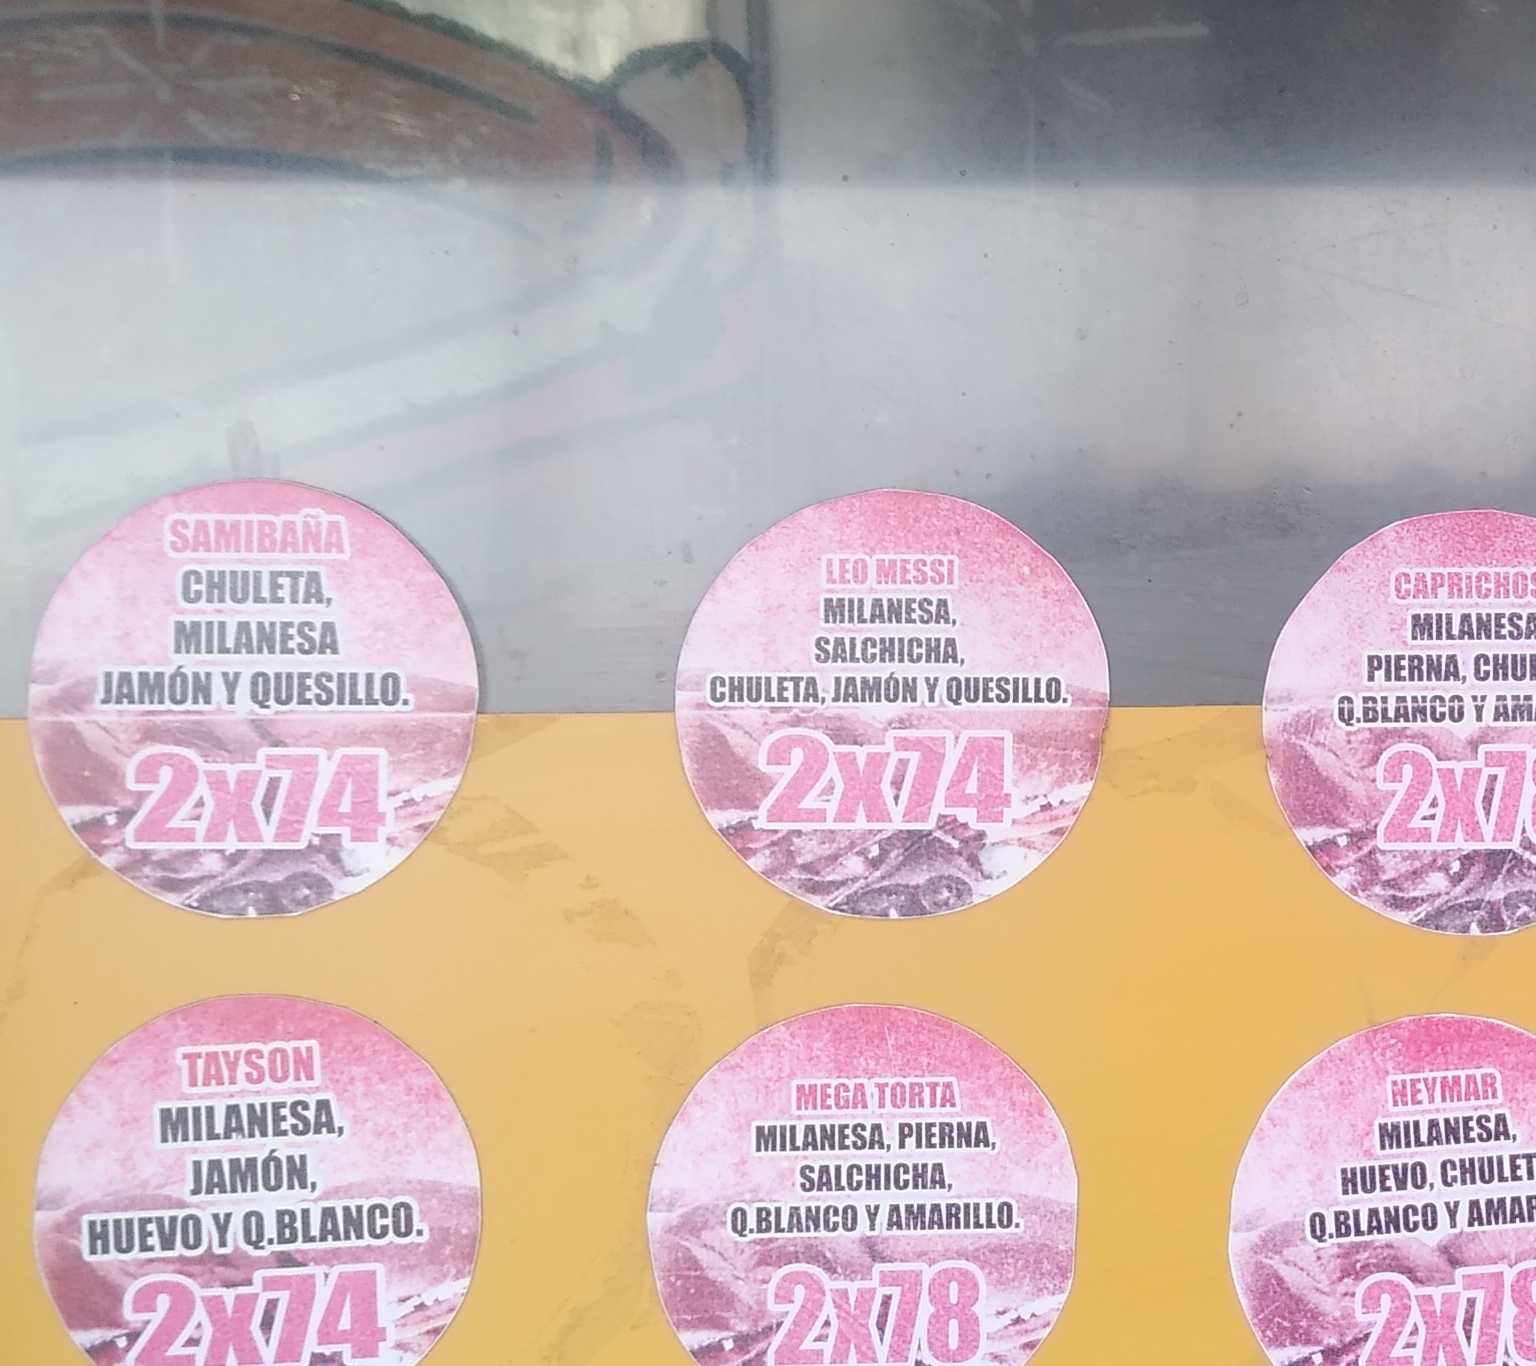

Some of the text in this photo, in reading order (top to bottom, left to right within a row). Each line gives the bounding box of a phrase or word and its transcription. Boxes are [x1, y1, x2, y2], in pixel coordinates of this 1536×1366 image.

[168, 513, 346, 555] SAMIBAÑA
[180, 569, 334, 608] CHULETA,
[824, 557, 956, 586] LEO MESSI
[822, 596, 959, 628] MILANESA,
[172, 619, 340, 656] MILANESA
[813, 635, 966, 667] SALCHICHA,
[1365, 652, 1468, 685] PIERNA,
[99, 665, 411, 710] JAMÓN Y QUESILLO.
[708, 671, 1070, 708] CHULETA, JAMÓN Y QUESILLO.
[1471, 694, 1489, 723] Y
[181, 1045, 316, 1089] TAYSON
[794, 1080, 957, 1111] MEGA TORTA
[1390, 1072, 1500, 1108] NEYMAR
[157, 1098, 345, 1144] MILANESA,
[753, 1120, 998, 1154] MILANESA, PIERNA,
[1376, 1112, 1518, 1151] MILANESA,
[188, 1147, 318, 1197] JAMÓN,
[799, 1162, 954, 1194] SALCHICHA,
[1339, 1160, 1435, 1197] HUEVO,
[863, 1203, 882, 1232] Y
[885, 1200, 1021, 1232] AMARILLO.
[1443, 1200, 1463, 1230] Y
[86, 1213, 203, 1257] HUEVO
[207, 1212, 233, 1249] Y
